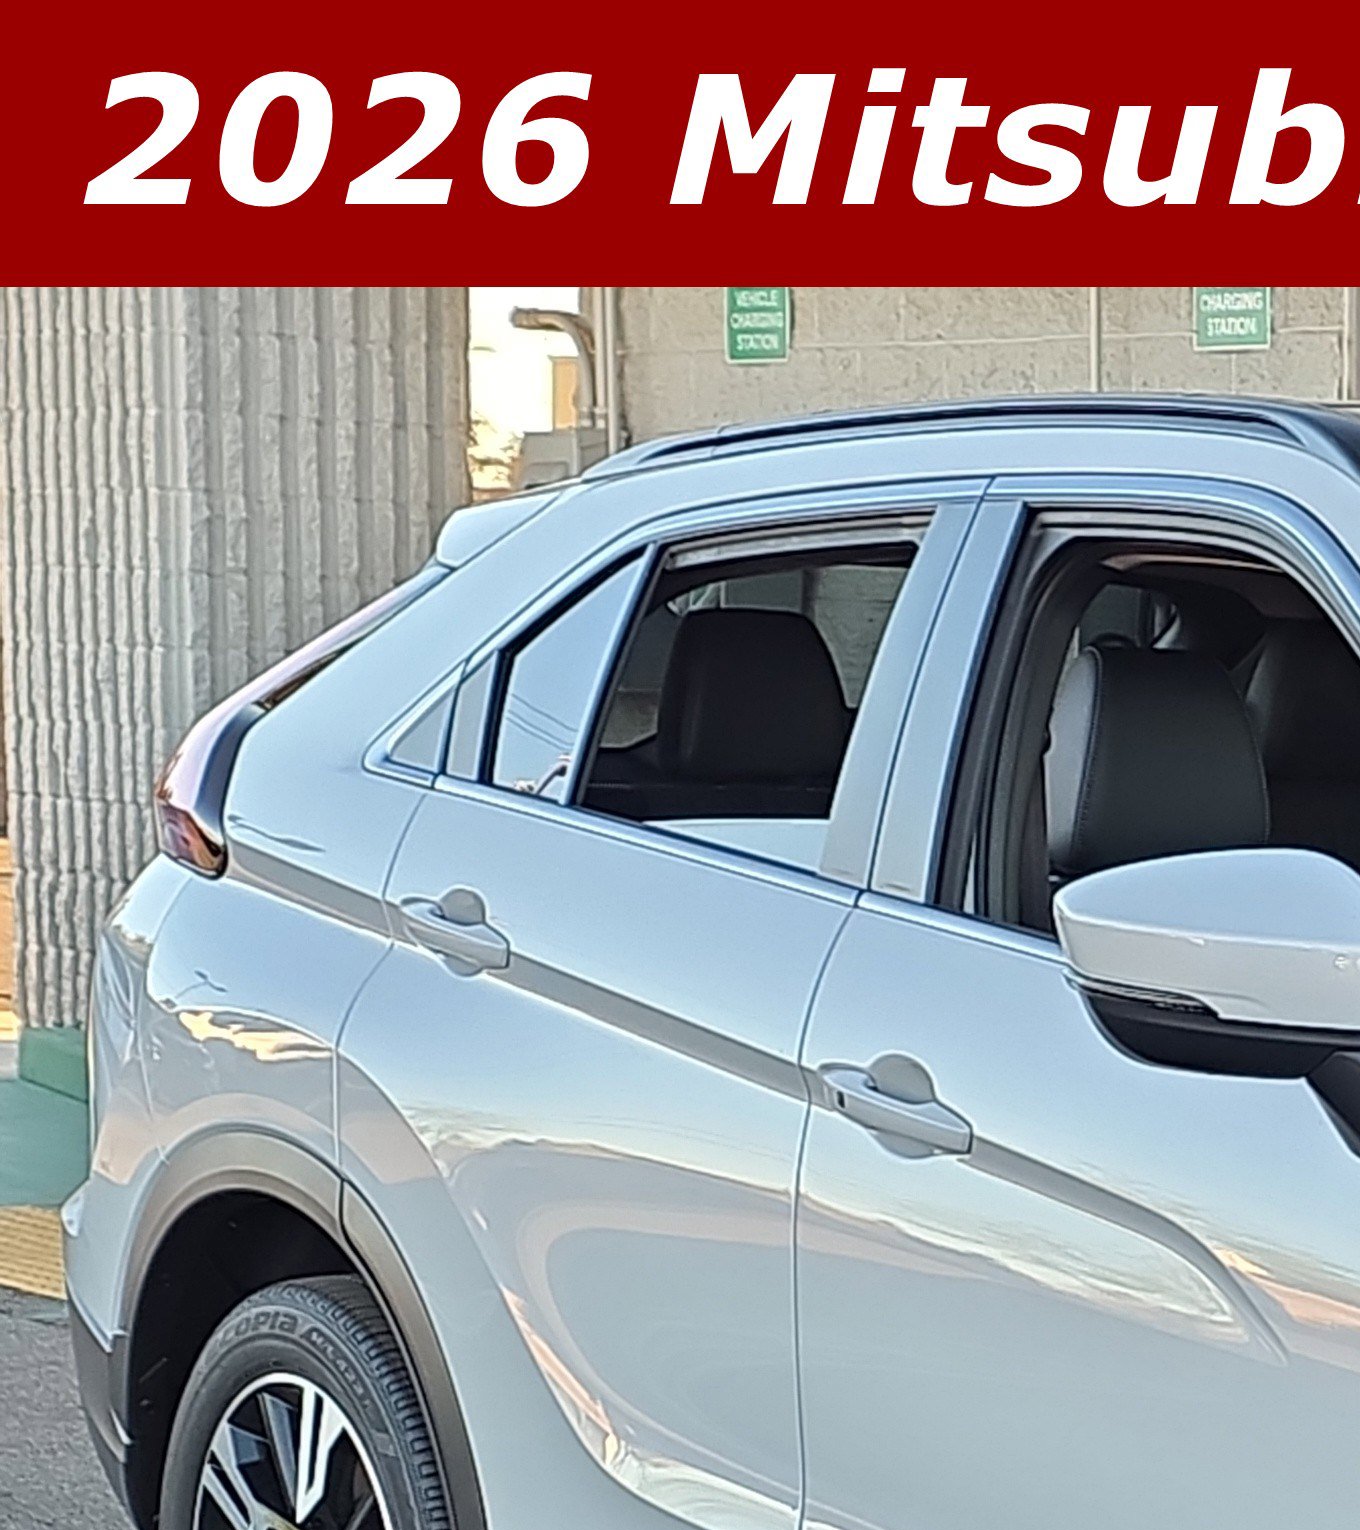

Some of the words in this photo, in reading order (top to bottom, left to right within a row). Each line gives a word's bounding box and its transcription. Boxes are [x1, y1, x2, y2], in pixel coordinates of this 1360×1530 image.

[733, 289, 779, 307] VEHICLE
[1199, 291, 1264, 312] CHARGING
[729, 311, 785, 329] CHARGING
[1206, 316, 1258, 337] STATION
[735, 333, 779, 351] STATION
